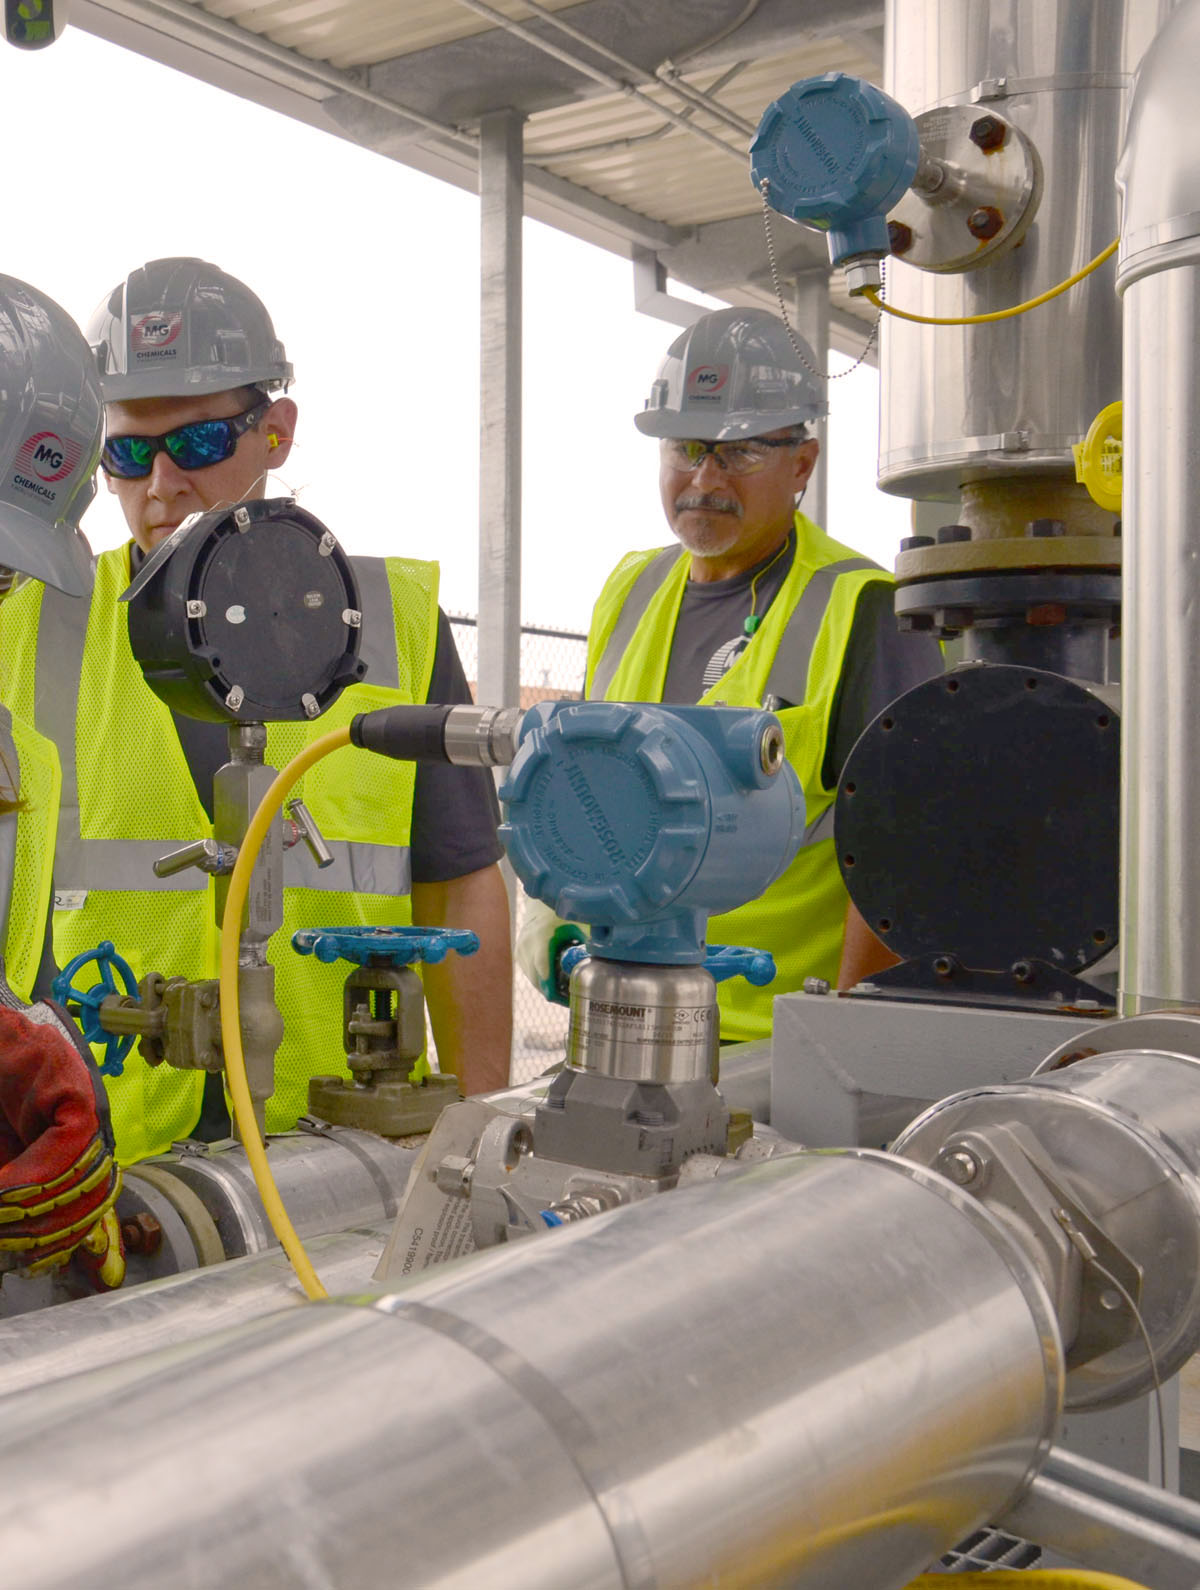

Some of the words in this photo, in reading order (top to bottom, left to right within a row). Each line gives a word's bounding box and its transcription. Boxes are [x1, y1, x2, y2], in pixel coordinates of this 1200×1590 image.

[136, 349, 177, 359] CHEMICALS
[14, 474, 57, 501] CHEMICALS
[589, 1001, 646, 1019] ROSEMOUNT
